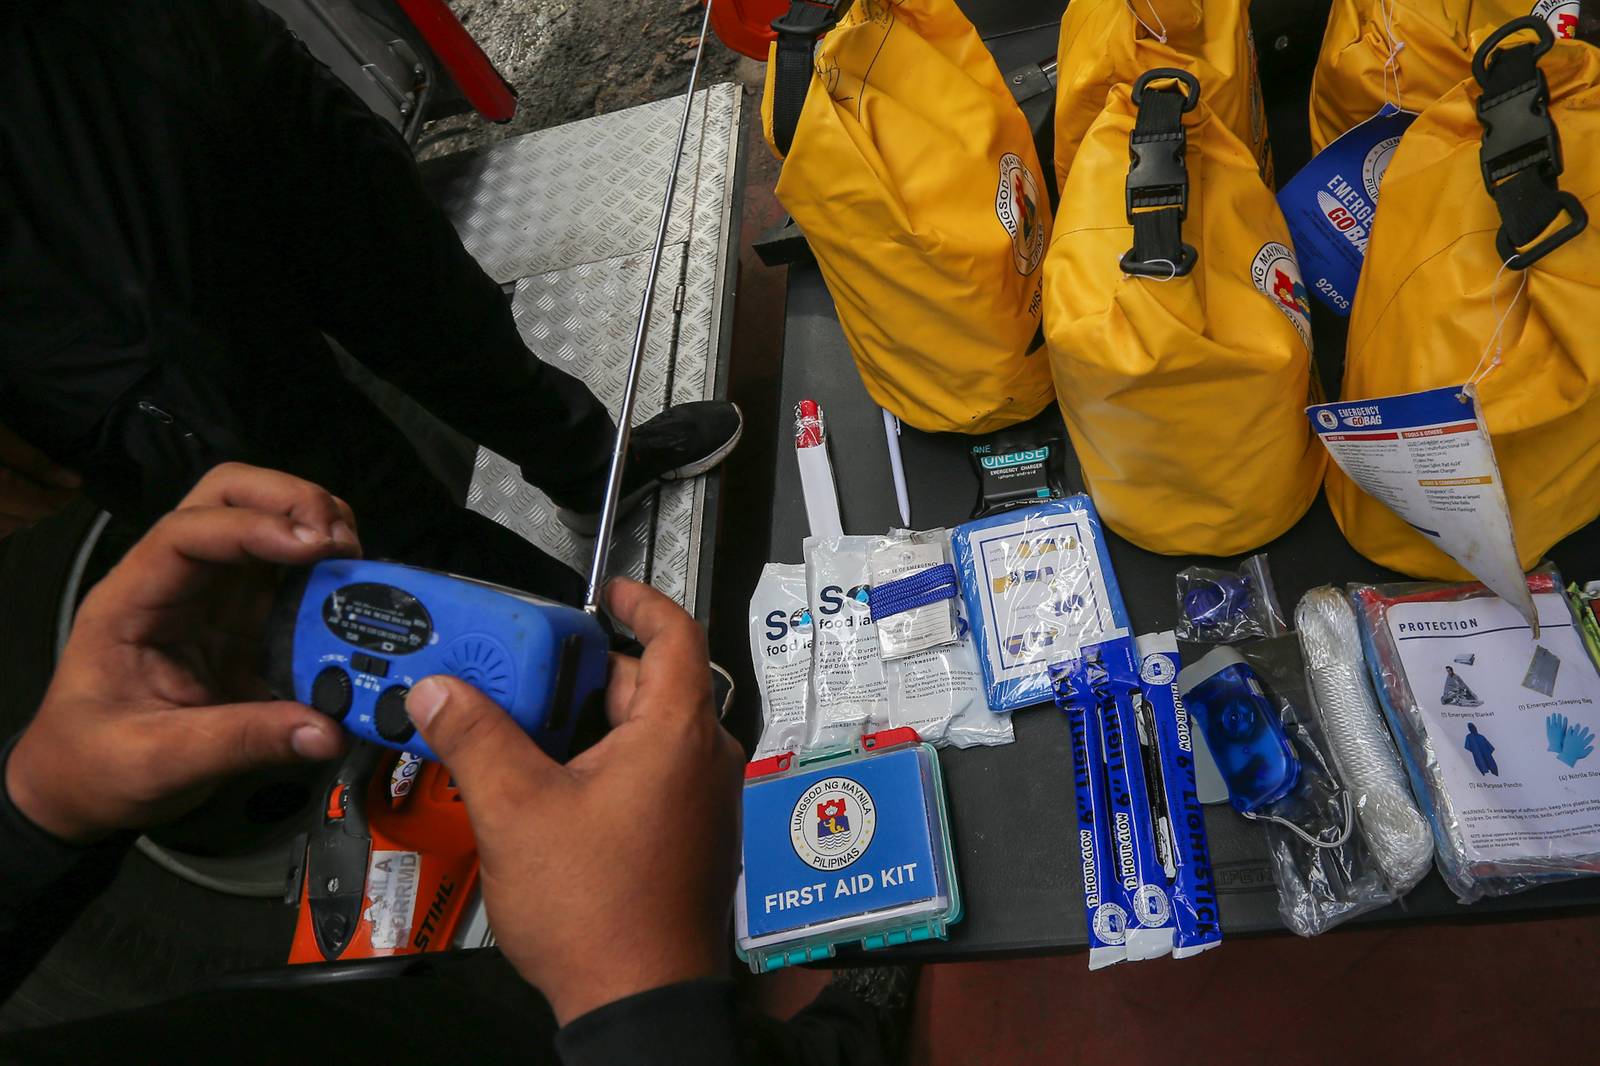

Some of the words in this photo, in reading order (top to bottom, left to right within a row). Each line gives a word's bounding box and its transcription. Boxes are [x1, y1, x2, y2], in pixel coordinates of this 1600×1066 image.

[1327, 174, 1375, 230] EMERGE
[1316, 278, 1349, 309] 92PCS
[1338, 405, 1380, 418] EMERGENCY
[990, 467, 1018, 476] EMERGENCY
[1020, 463, 1043, 471] CHARGER
[906, 562, 938, 571] EMERGENCY
[1399, 618, 1478, 633] PROTECTION
[766, 639, 798, 657] food
[1526, 702, 1557, 710] Emergency
[1558, 699, 1582, 707] Sleeping
[794, 786, 822, 832] LUNGSOD
[824, 781, 839, 791] NG
[841, 782, 872, 816] MAYNILA
[1117, 813, 1131, 844] GLOW
[813, 847, 860, 868] PILIPINAS
[1081, 831, 1095, 863] GLOW
[1122, 845, 1135, 877] HOUR
[1083, 862, 1098, 893] HOUR
[1183, 789, 1217, 938] LIGHTSTICK
[765, 882, 827, 914] FIRST
[834, 873, 874, 899] AID
[881, 863, 917, 888] KIT
[1126, 877, 1138, 890] 12
[413, 880, 455, 952] STIHL
[1087, 895, 1099, 908] 12
